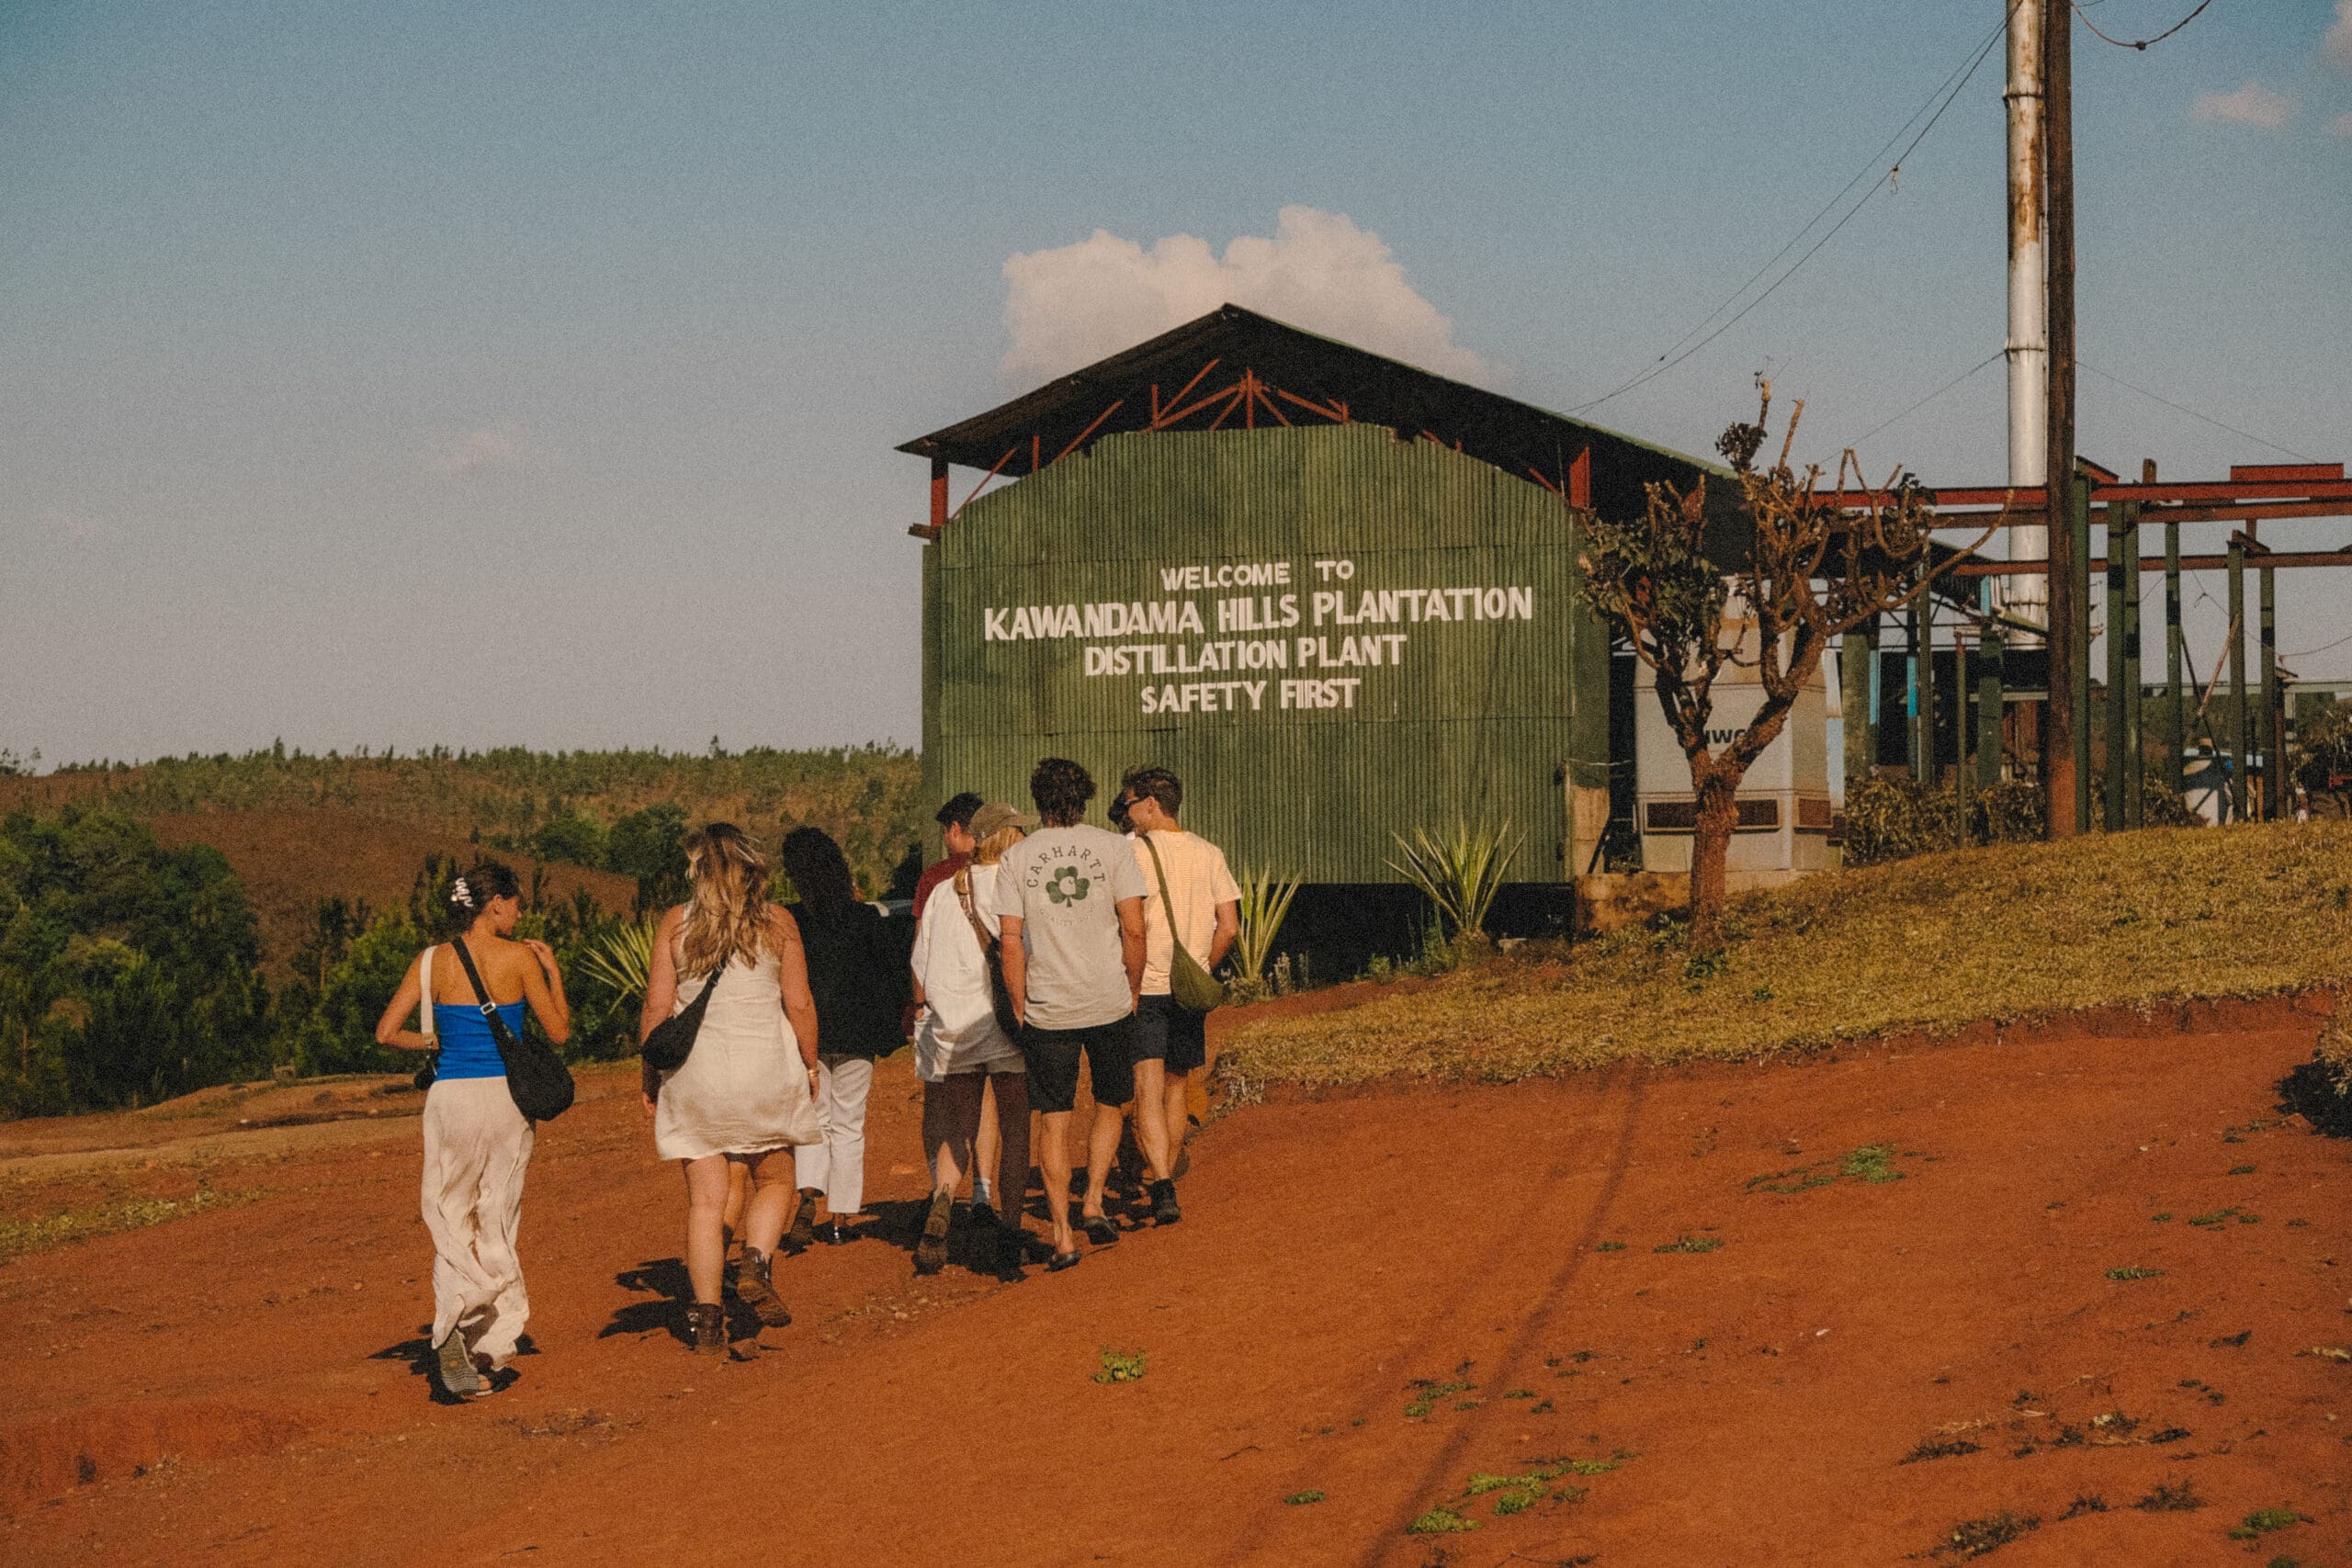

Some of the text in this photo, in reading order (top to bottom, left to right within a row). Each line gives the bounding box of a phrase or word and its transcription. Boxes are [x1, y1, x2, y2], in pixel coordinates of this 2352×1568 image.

[1161, 560, 1354, 591] WELCOME TO
[985, 587, 1532, 640] KAWANDAMA HILLS PLANTATION
[1085, 635, 1407, 676] DISTILLATION PLANT
[1141, 678, 1361, 713] SAFETY FIRST
[1026, 845, 1105, 887] CARHARTT
